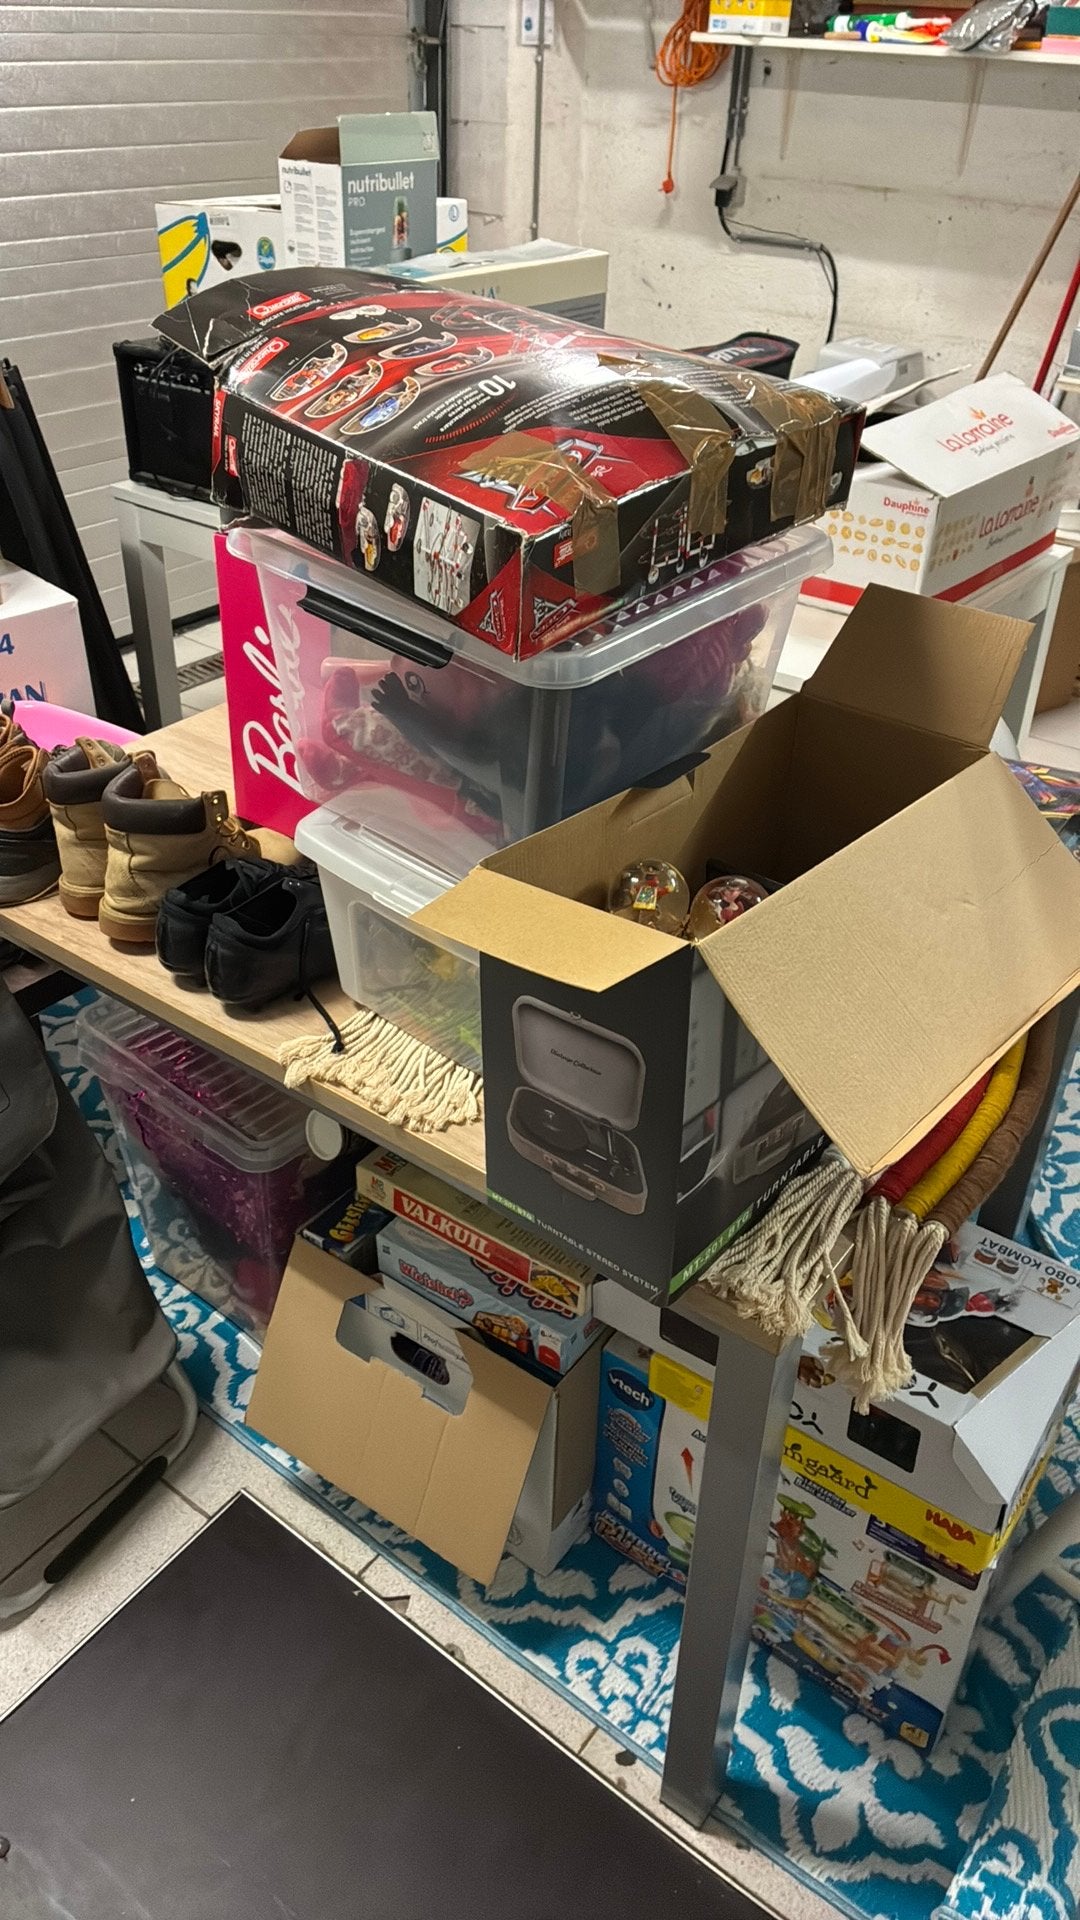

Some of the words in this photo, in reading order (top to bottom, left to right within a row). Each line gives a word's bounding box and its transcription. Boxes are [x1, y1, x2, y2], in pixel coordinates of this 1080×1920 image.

[347, 172, 415, 194] nutribullet
[348, 197, 366, 207] PRO
[478, 374, 518, 394] 10
[213, 399, 221, 437] SKYRAIL
[412, 417, 428, 431] track
[883, 497, 929, 513] Dauphine
[679, 1236, 726, 1283] MT-201
[753, 1133, 828, 1208] TURNTABLE
[401, 1196, 491, 1258] VALKUIL
[534, 1218, 584, 1251] TURNTABLE
[584, 1247, 621, 1272] STEREO
[621, 1269, 660, 1294] SYSTEM
[979, 1237, 1043, 1270] KOMBAT
[925, 1508, 977, 1546] HABA
